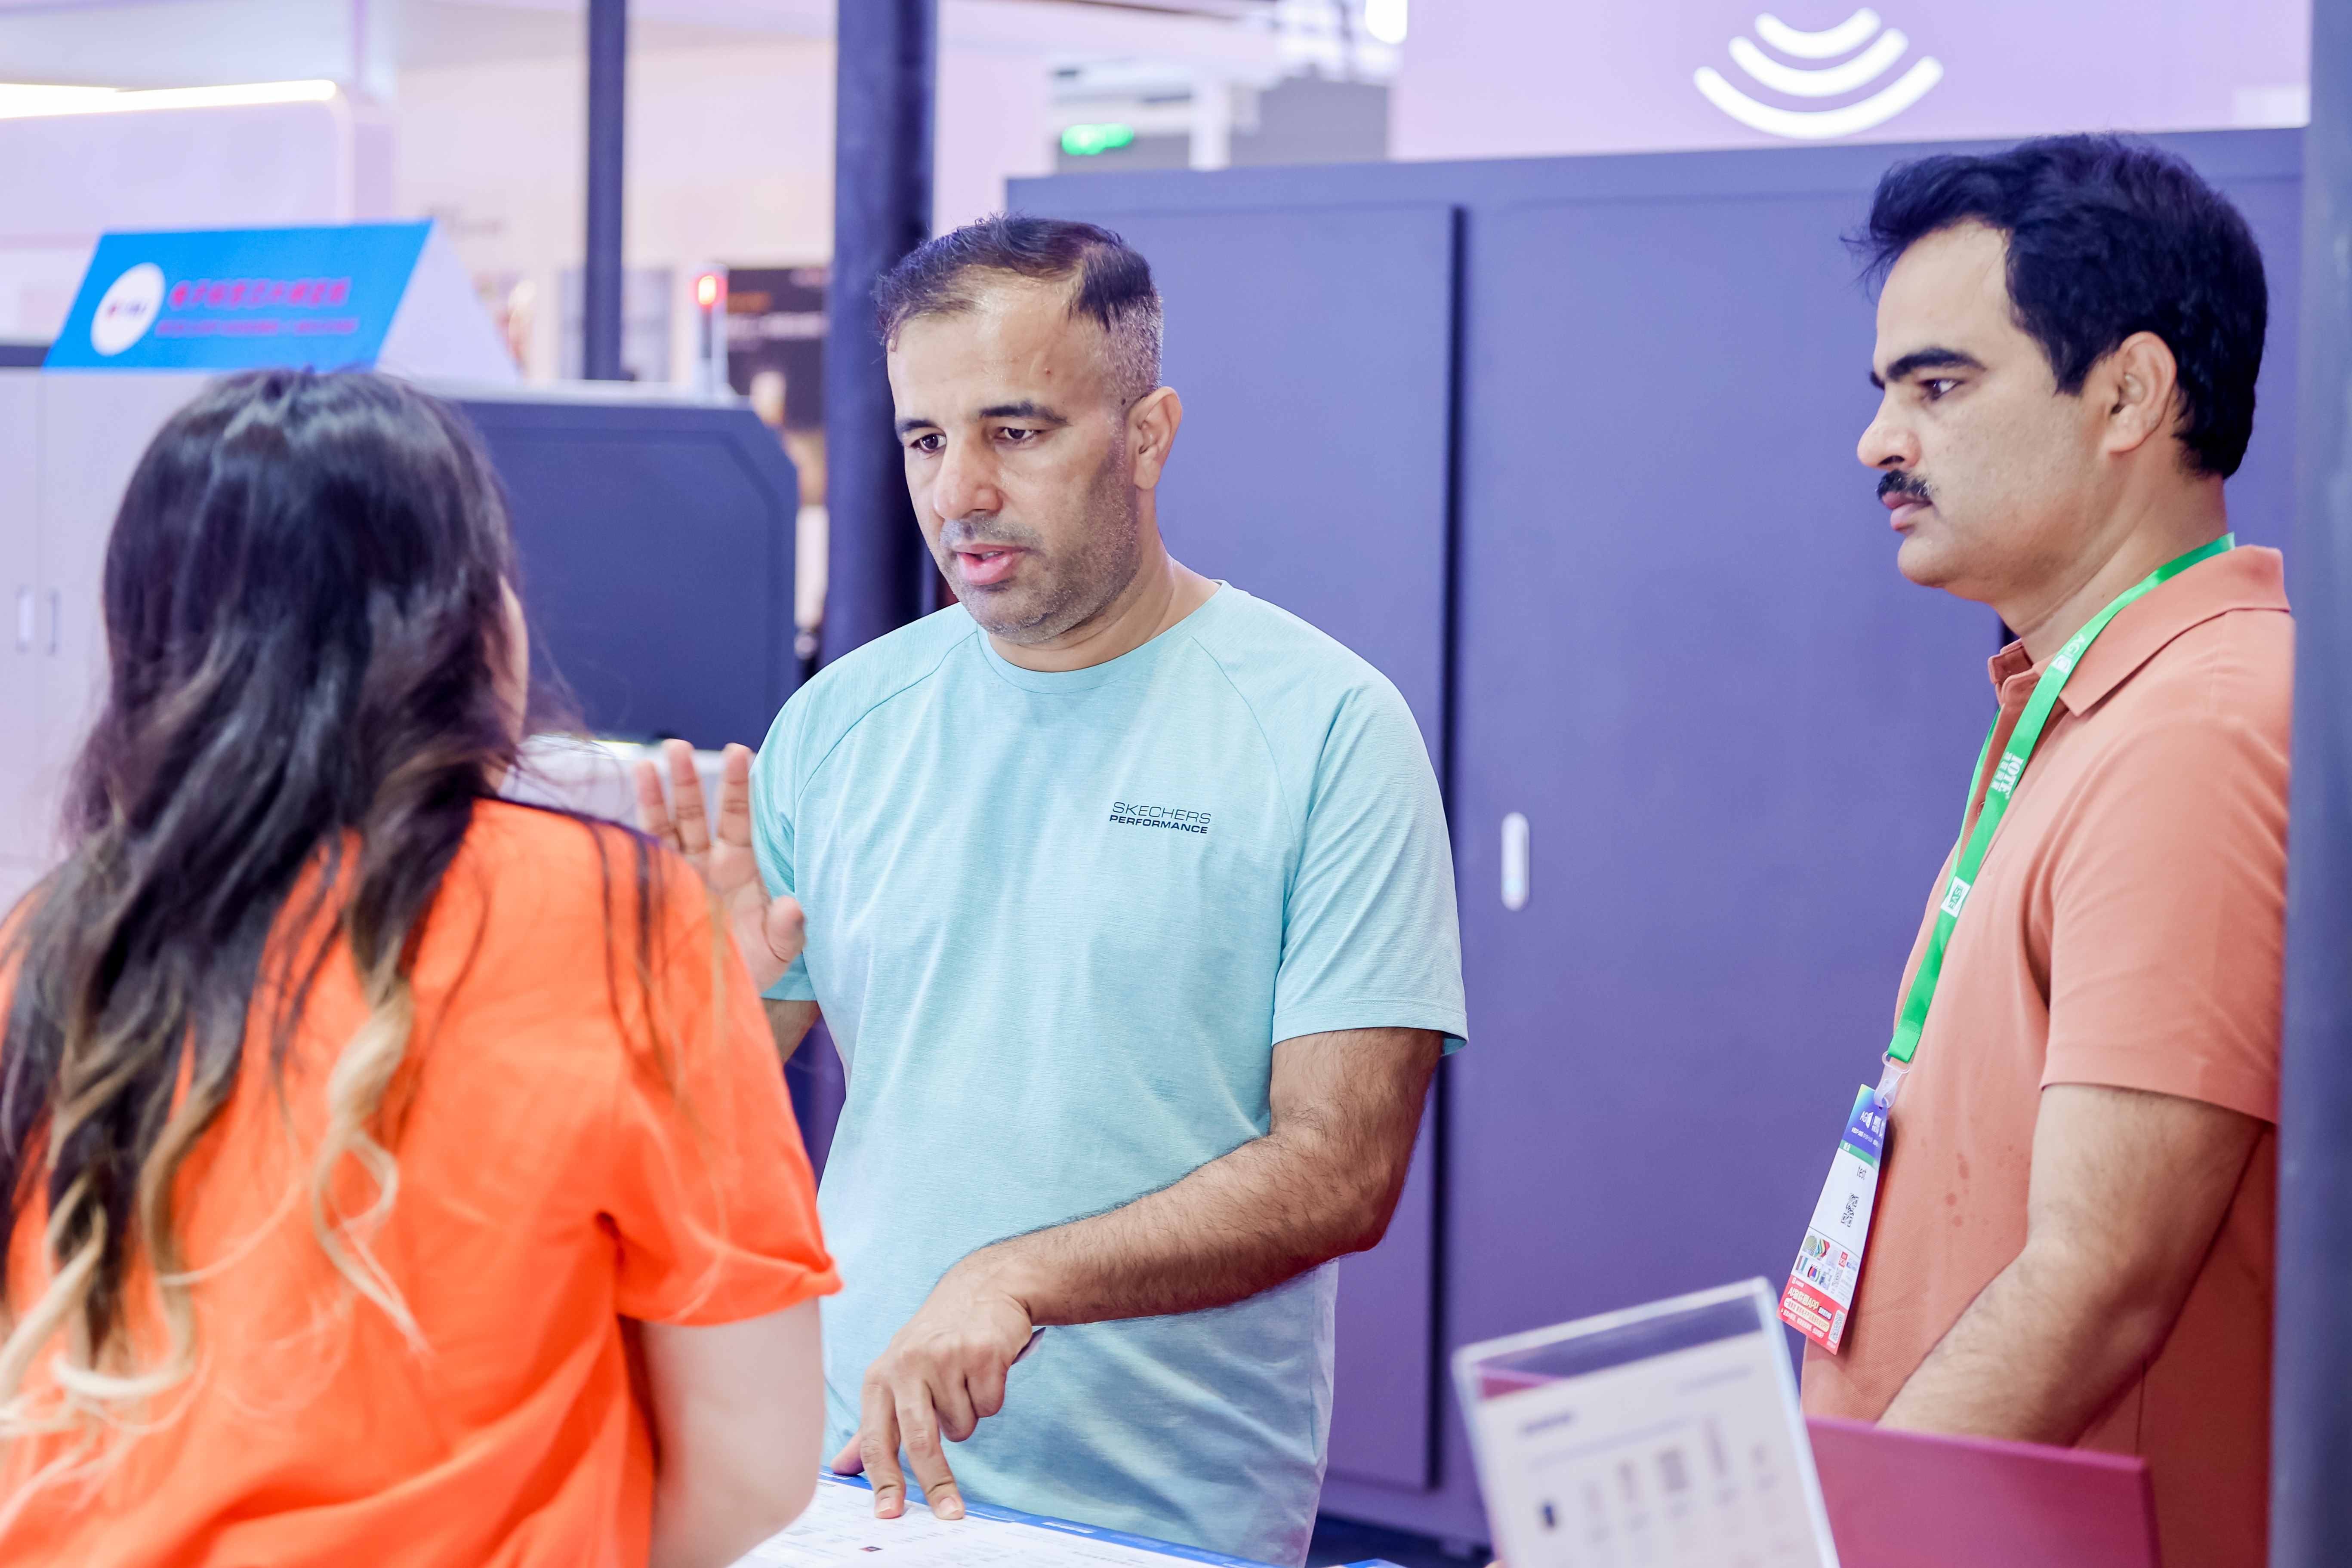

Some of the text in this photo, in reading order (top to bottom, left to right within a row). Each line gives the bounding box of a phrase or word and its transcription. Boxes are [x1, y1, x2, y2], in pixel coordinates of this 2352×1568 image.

[1997, 754, 2024, 792] IOTE
[1112, 802, 1211, 824] SKECHERS
[1109, 815, 1208, 834] PERFORMANCE
